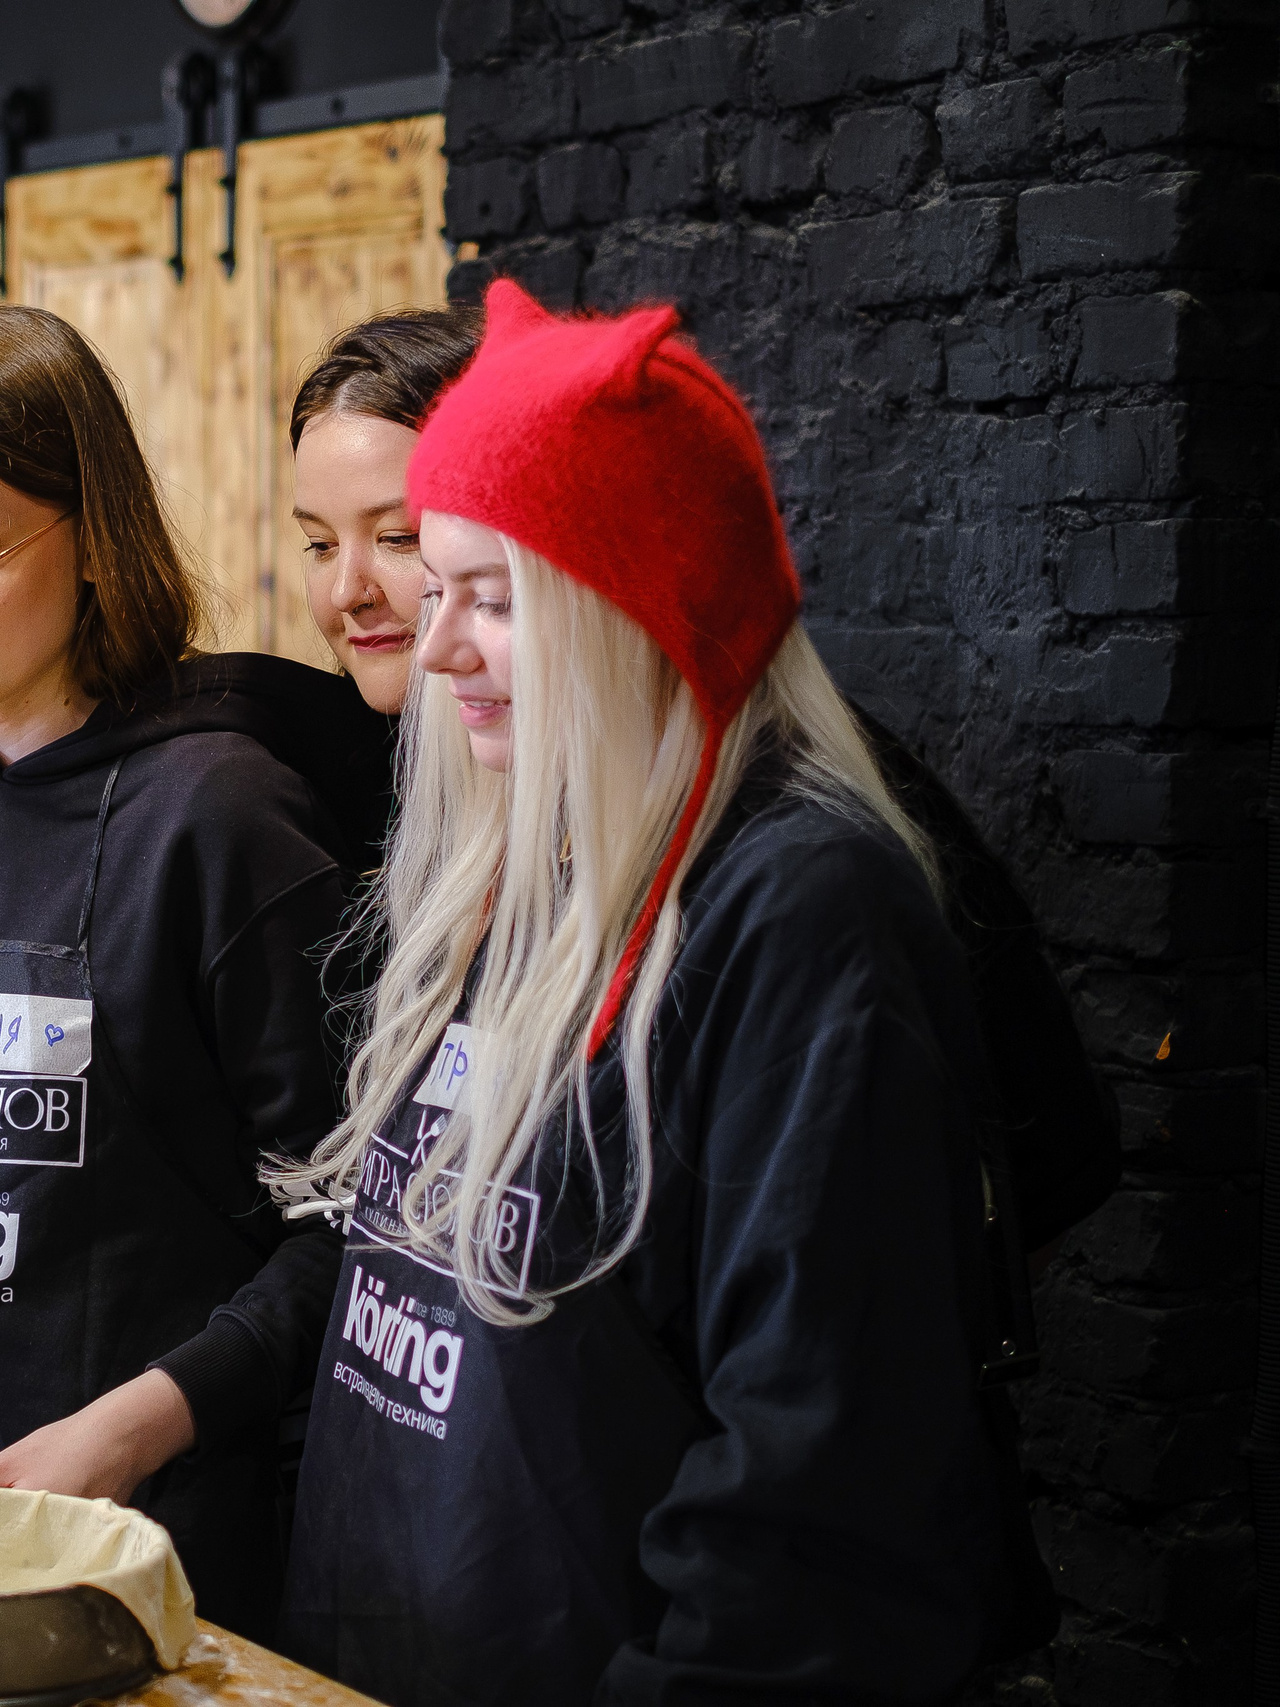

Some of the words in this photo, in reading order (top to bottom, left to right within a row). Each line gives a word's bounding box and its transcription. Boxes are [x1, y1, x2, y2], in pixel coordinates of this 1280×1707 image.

[429, 1304, 457, 1329] 1889
[342, 1265, 465, 1414] körting
[384, 1398, 448, 1441] техника
